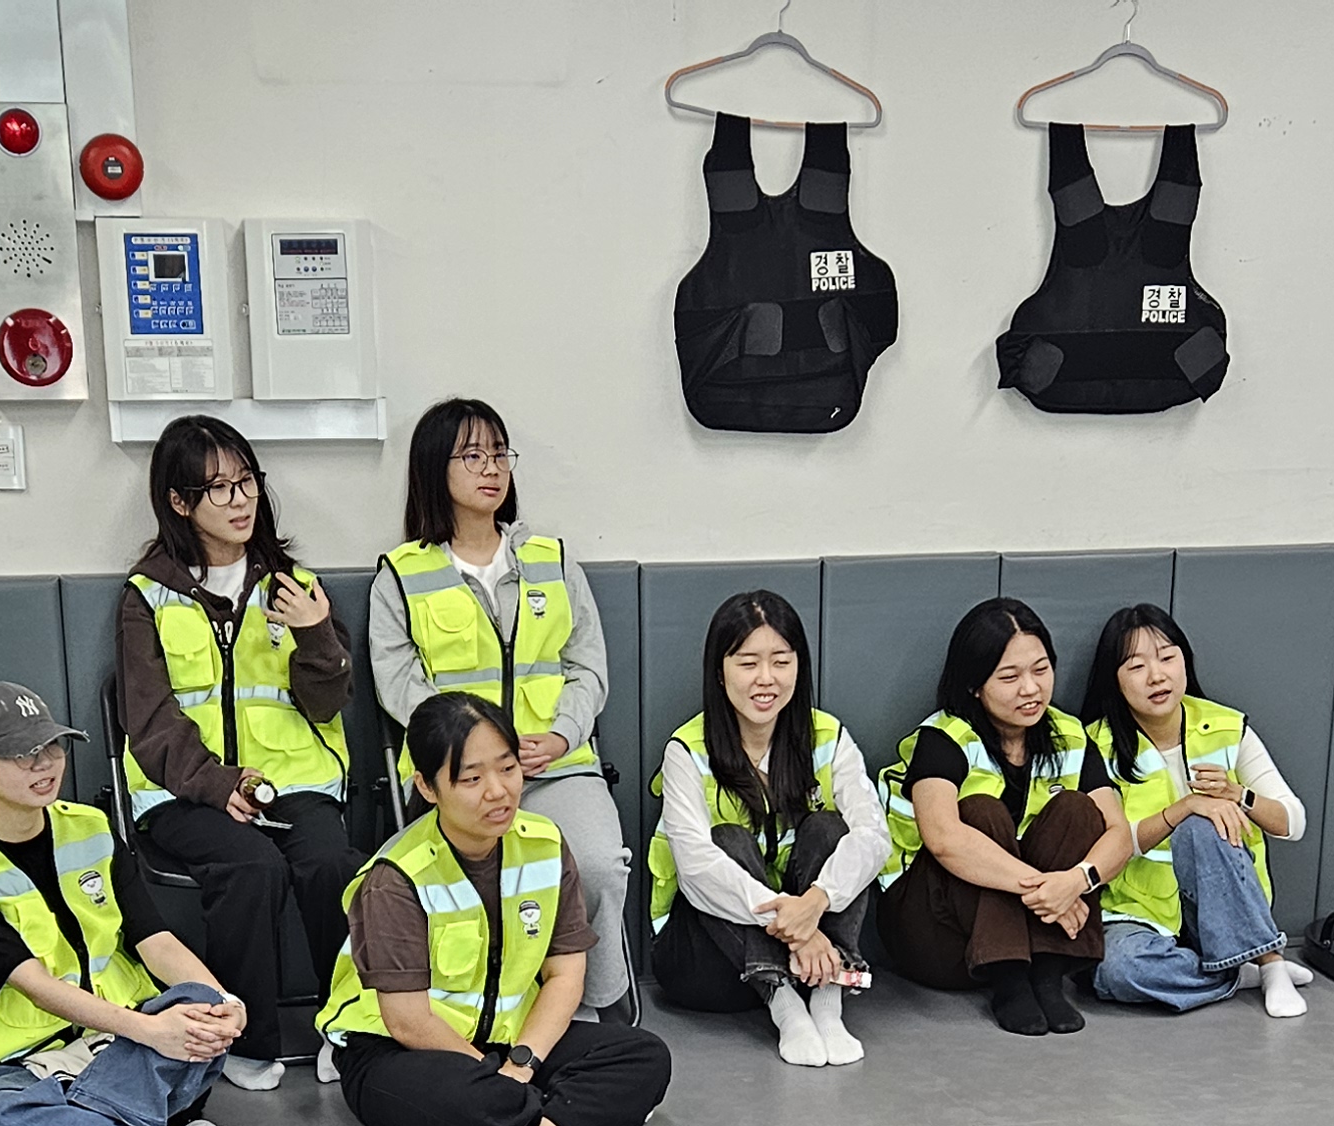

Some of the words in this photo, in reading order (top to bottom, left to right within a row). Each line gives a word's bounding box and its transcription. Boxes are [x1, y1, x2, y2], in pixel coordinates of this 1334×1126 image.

[815, 253, 849, 275] 경찰
[812, 276, 856, 292] POLICE
[1147, 287, 1182, 308] 경찰
[1141, 310, 1185, 324] POLICE
[15, 695, 40, 717] NY
